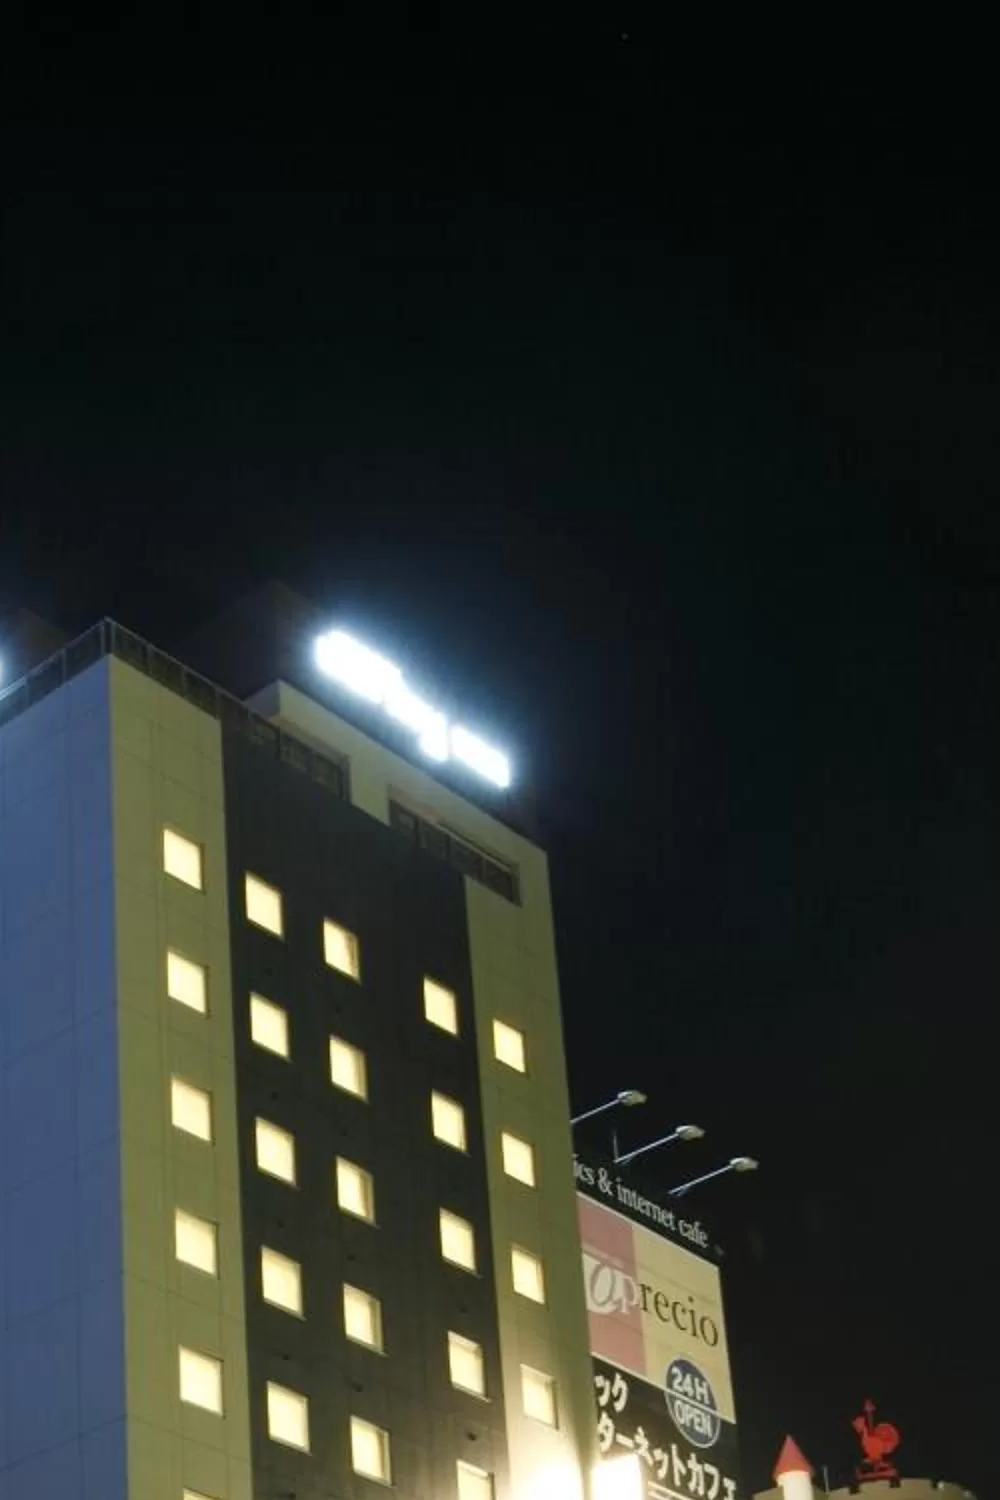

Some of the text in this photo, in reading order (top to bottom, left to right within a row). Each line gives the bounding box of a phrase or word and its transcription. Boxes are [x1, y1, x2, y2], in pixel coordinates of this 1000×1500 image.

[597, 1167, 614, 1196] &
[615, 1176, 677, 1232] internet
[671, 1366, 711, 1406] 24H
[674, 1400, 713, 1438] OPEN
